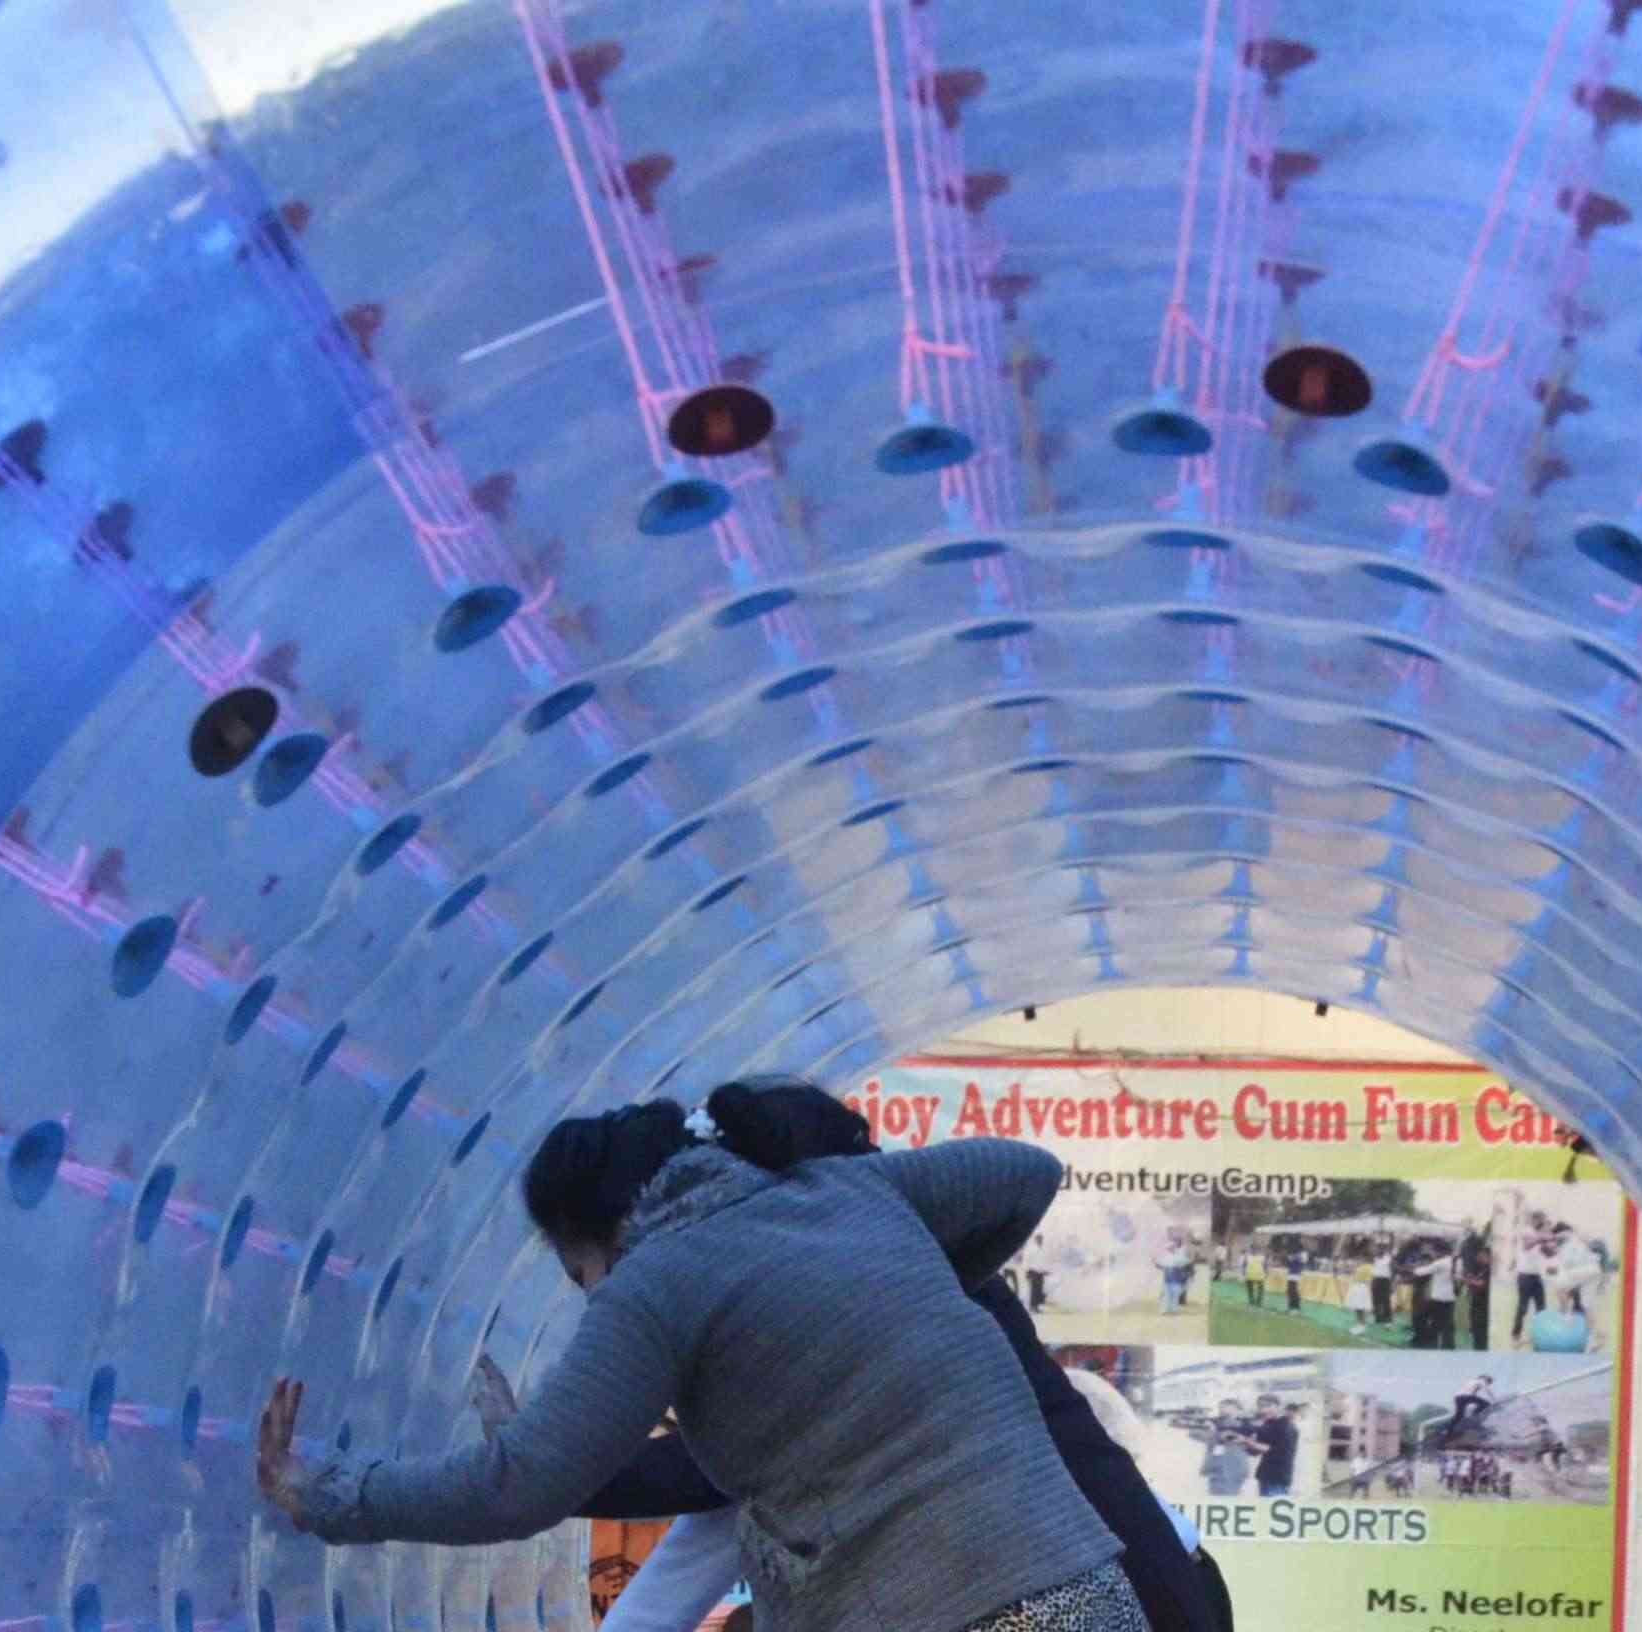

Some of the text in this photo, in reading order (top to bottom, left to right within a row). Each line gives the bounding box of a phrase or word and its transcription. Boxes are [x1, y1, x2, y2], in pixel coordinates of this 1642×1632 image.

[844, 1081, 941, 1148] joy
[952, 1081, 1218, 1139] Adventure
[1233, 1083, 1347, 1141] Cum
[1362, 1086, 1458, 1143] Fun
[1220, 1167, 1332, 1201] Camp.
[1269, 1499, 1427, 1541] SPORTS
[1366, 1588, 1603, 1619] Ms. Neelofar
